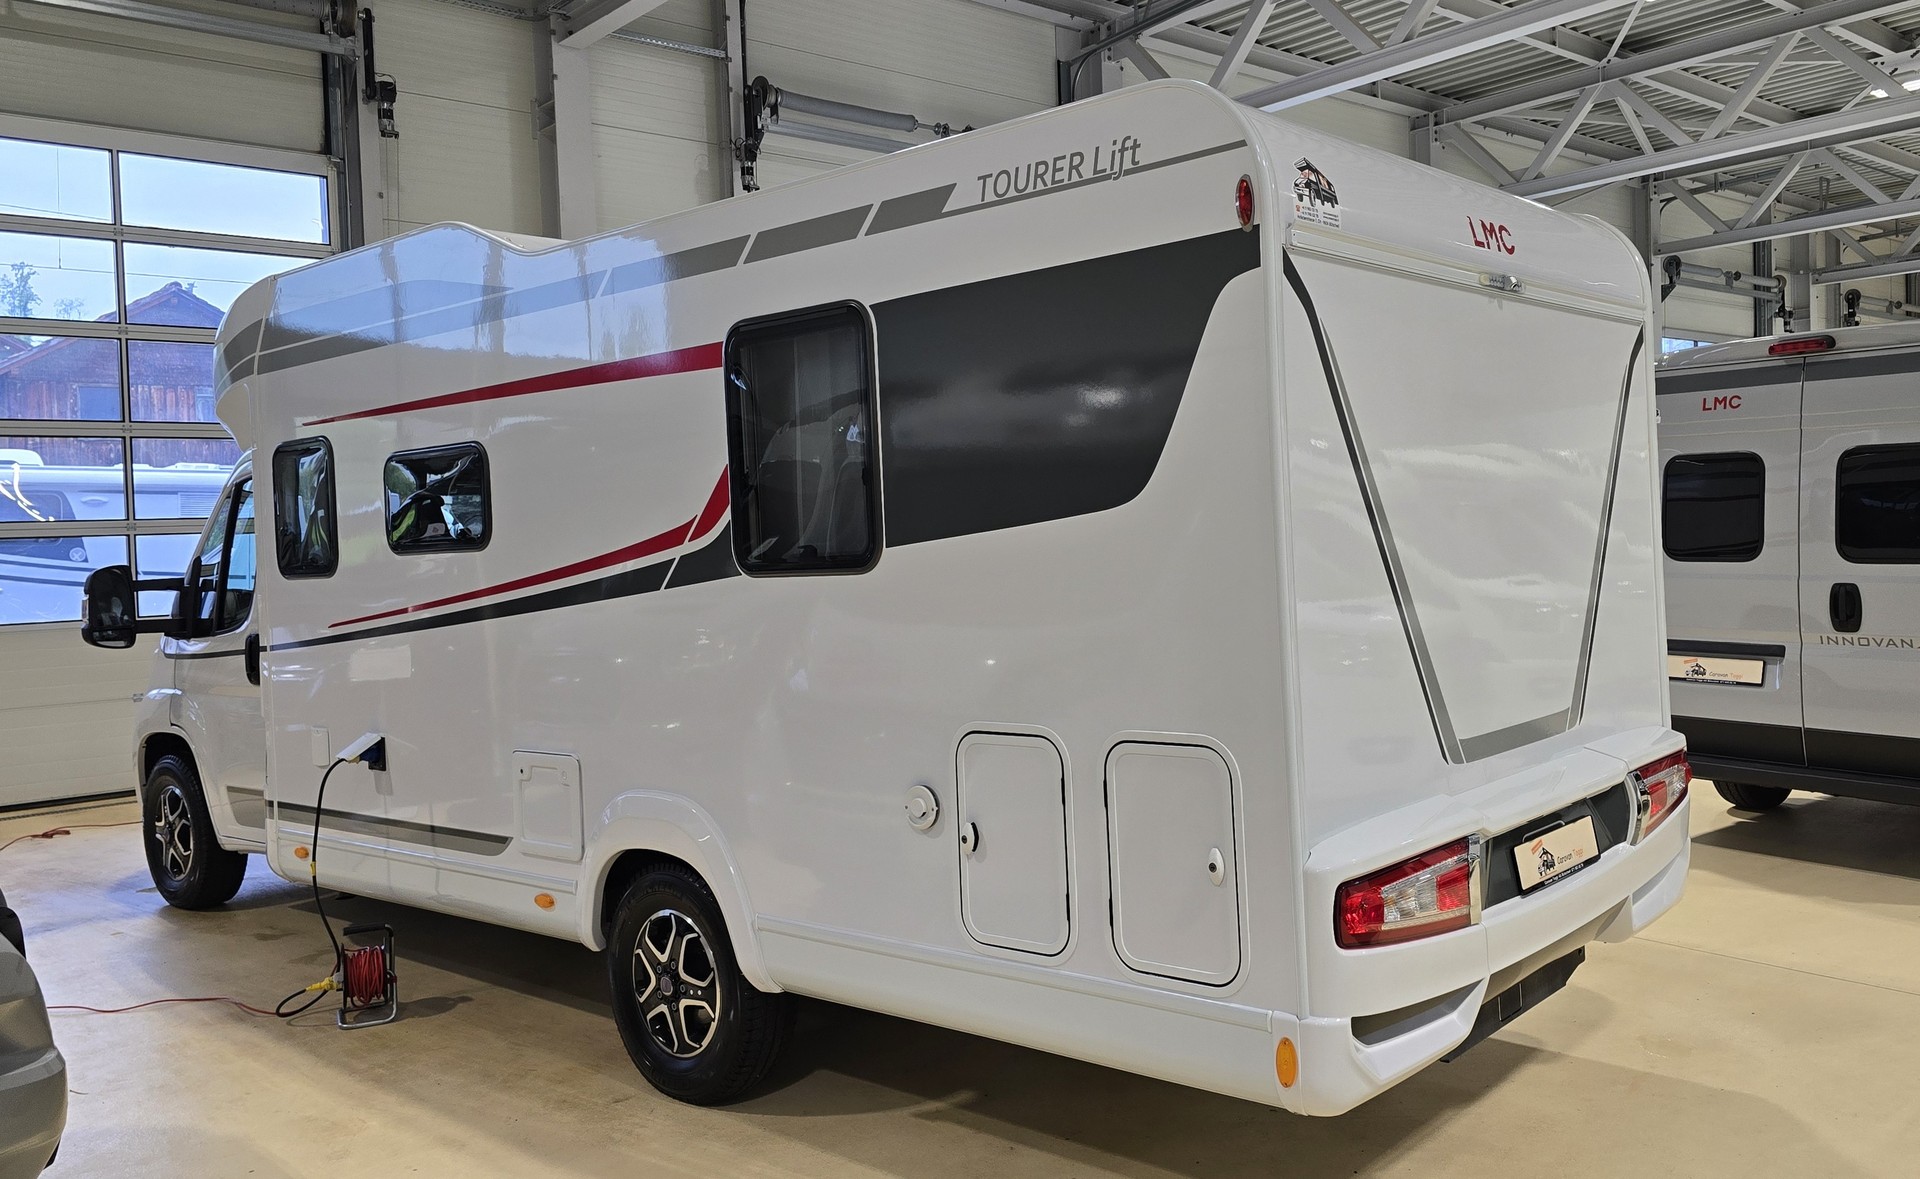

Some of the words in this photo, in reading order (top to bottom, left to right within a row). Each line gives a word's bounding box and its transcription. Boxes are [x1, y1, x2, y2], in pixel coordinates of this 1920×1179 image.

[977, 151, 1085, 202] TOURER
[1092, 135, 1141, 181] Lift
[1466, 215, 1516, 255] LMC
[1702, 395, 1742, 411] LMC
